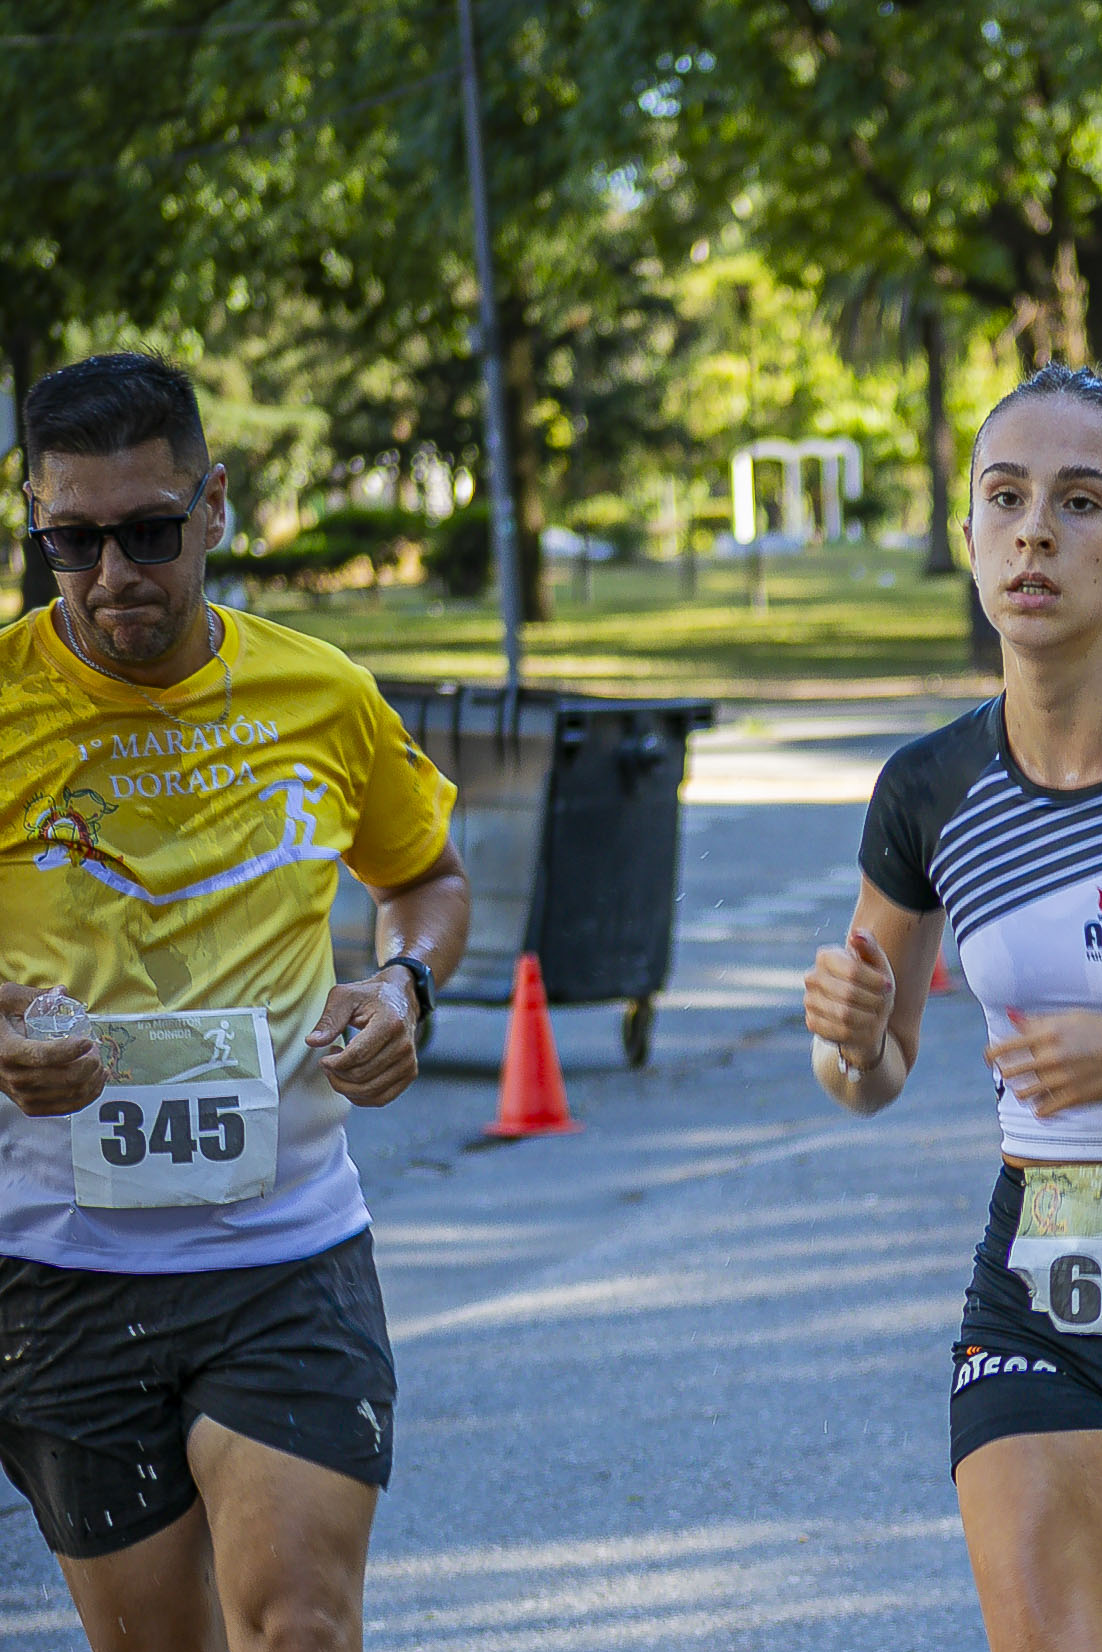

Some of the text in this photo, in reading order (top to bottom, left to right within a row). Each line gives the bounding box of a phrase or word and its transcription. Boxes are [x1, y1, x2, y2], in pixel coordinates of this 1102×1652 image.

[112, 715, 280, 760] MARATÓN
[109, 760, 260, 799] DORADA
[98, 1095, 246, 1166] 345
